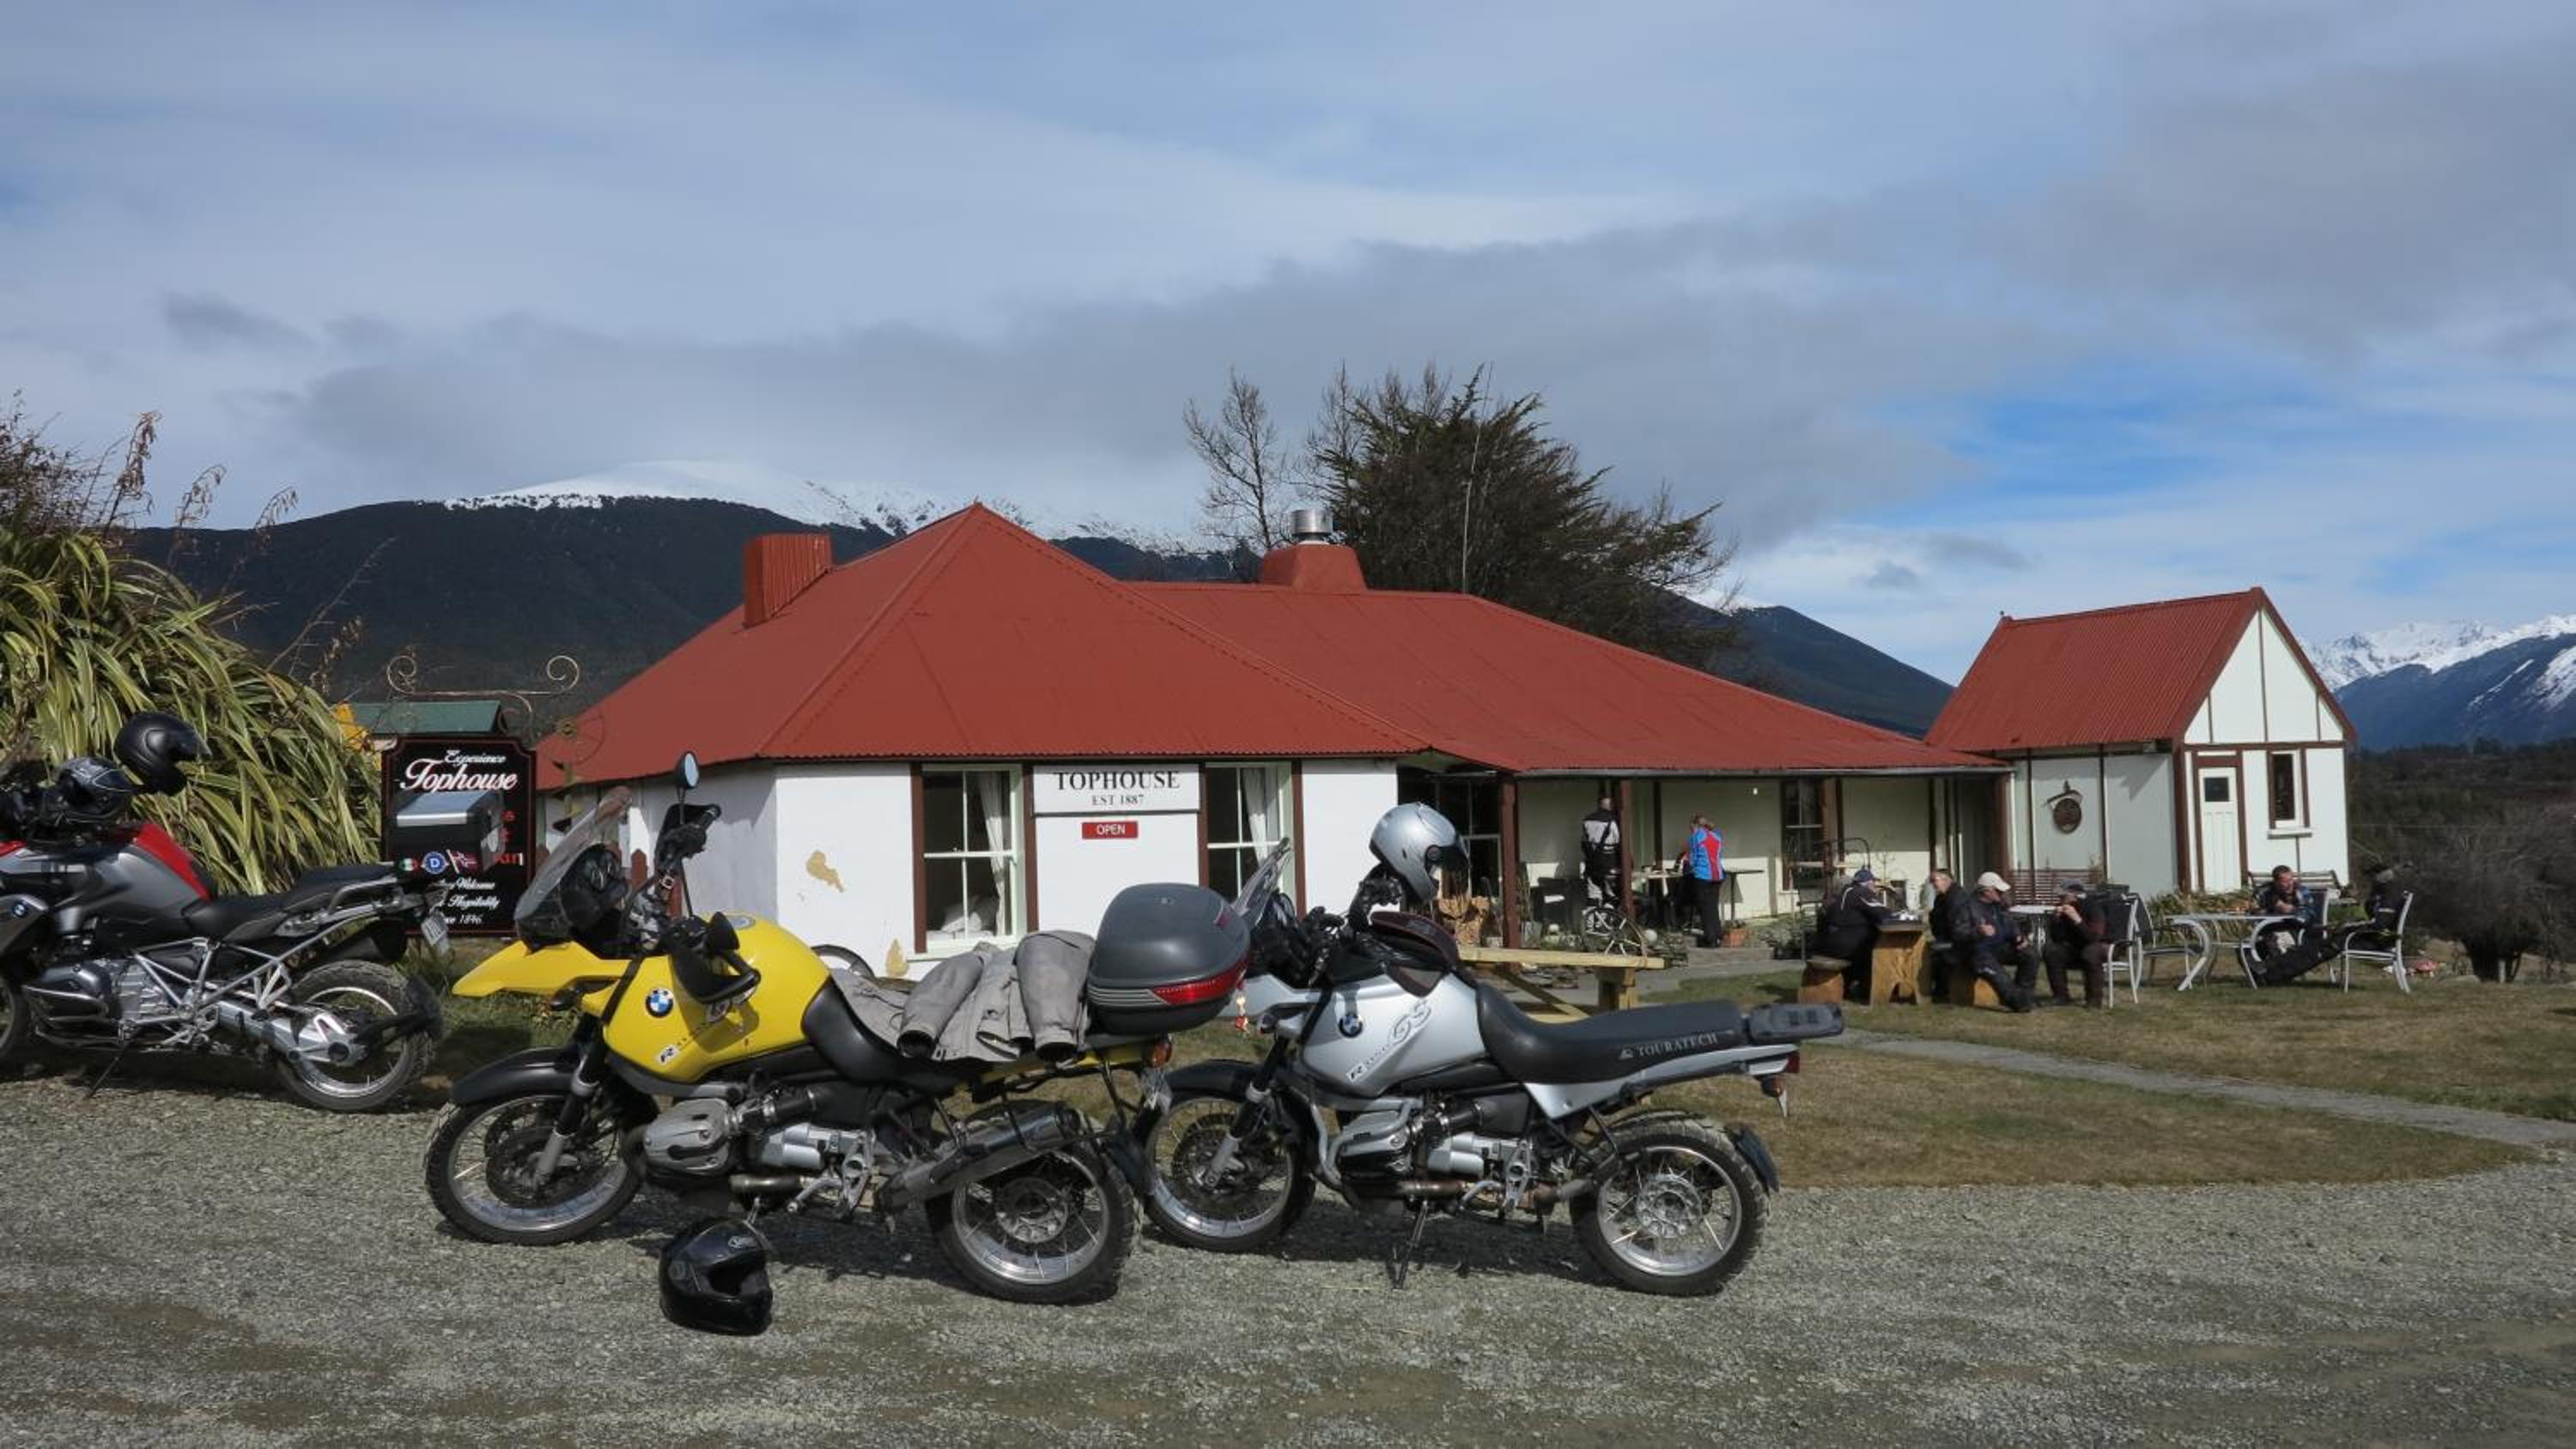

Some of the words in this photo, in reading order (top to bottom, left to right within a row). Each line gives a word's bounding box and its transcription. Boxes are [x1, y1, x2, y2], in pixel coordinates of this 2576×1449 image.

[443, 749, 506, 767] Experience
[399, 758, 519, 792] Tophouse
[1054, 770, 1181, 791] TOPHOUSE
[1091, 795, 1115, 806] EST
[1120, 794, 1144, 805] 1887
[1096, 824, 1126, 835] OPEN
[1638, 1032, 1717, 1058] TOURATECH
